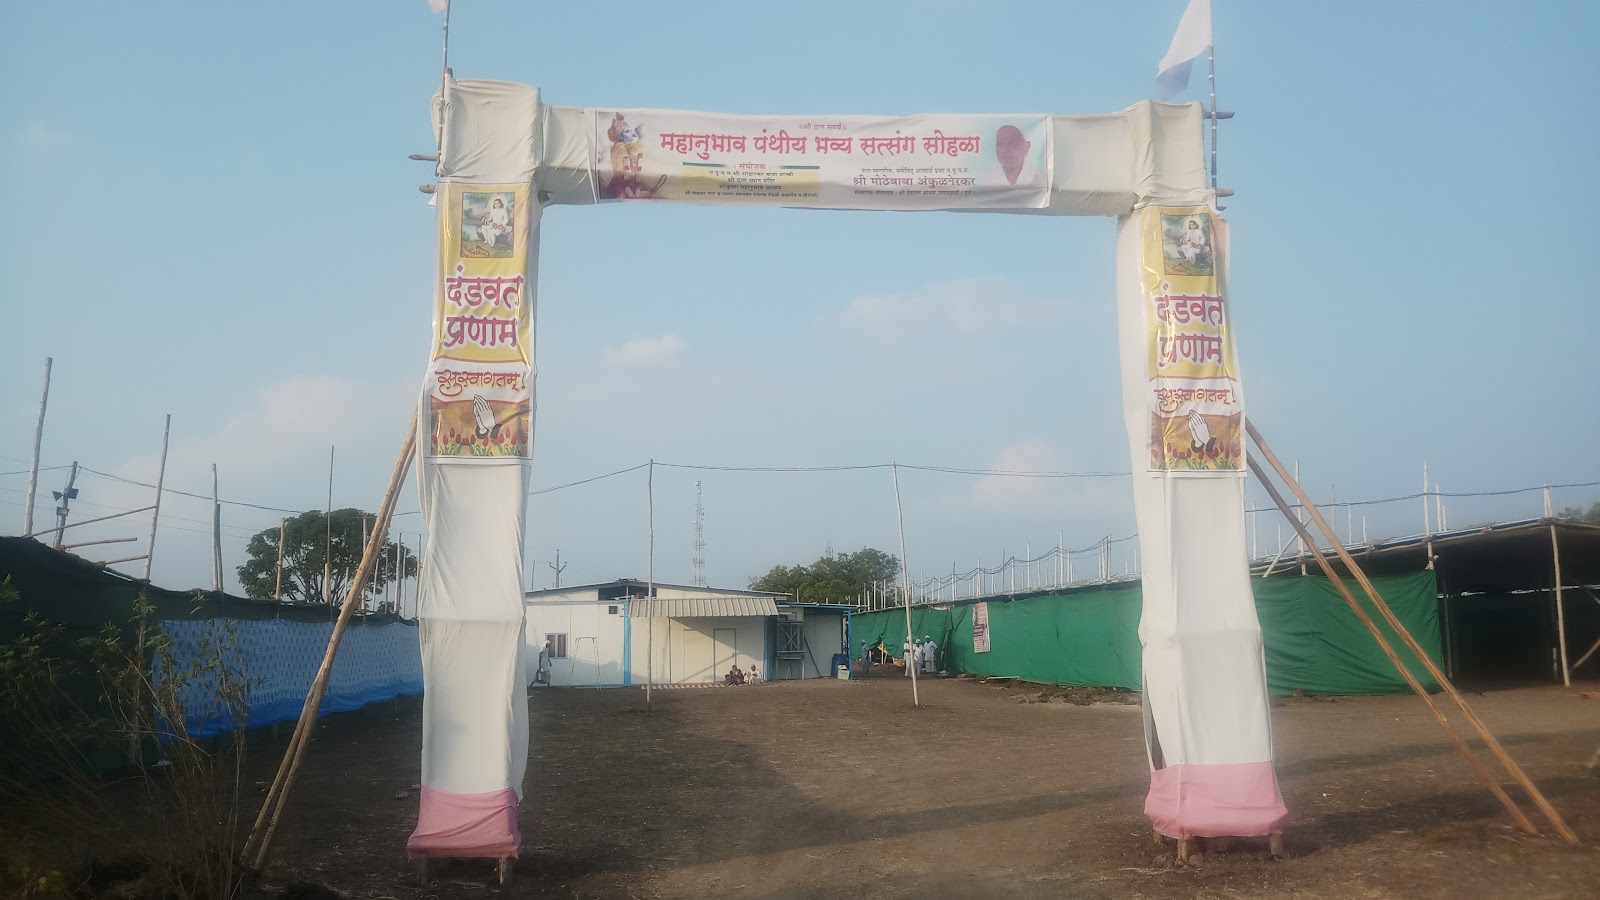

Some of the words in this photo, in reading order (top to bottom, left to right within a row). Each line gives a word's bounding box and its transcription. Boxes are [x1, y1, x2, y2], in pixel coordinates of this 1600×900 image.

[660, 132, 746, 160] महानुभाव
[753, 128, 807, 155] पंथीय
[815, 135, 853, 155] भव्य
[860, 130, 916, 157] सत्संग
[922, 129, 981, 157] सोहळा
[853, 173, 867, 186] श्री
[870, 174, 914, 186] मोठेबाबा
[917, 174, 976, 189] अंकुळनेरकर
[445, 265, 524, 308] दंडवत
[1153, 283, 1224, 326] दंडवत
[443, 316, 519, 348] प्रणाम
[1158, 333, 1223, 367] प्रणाम
